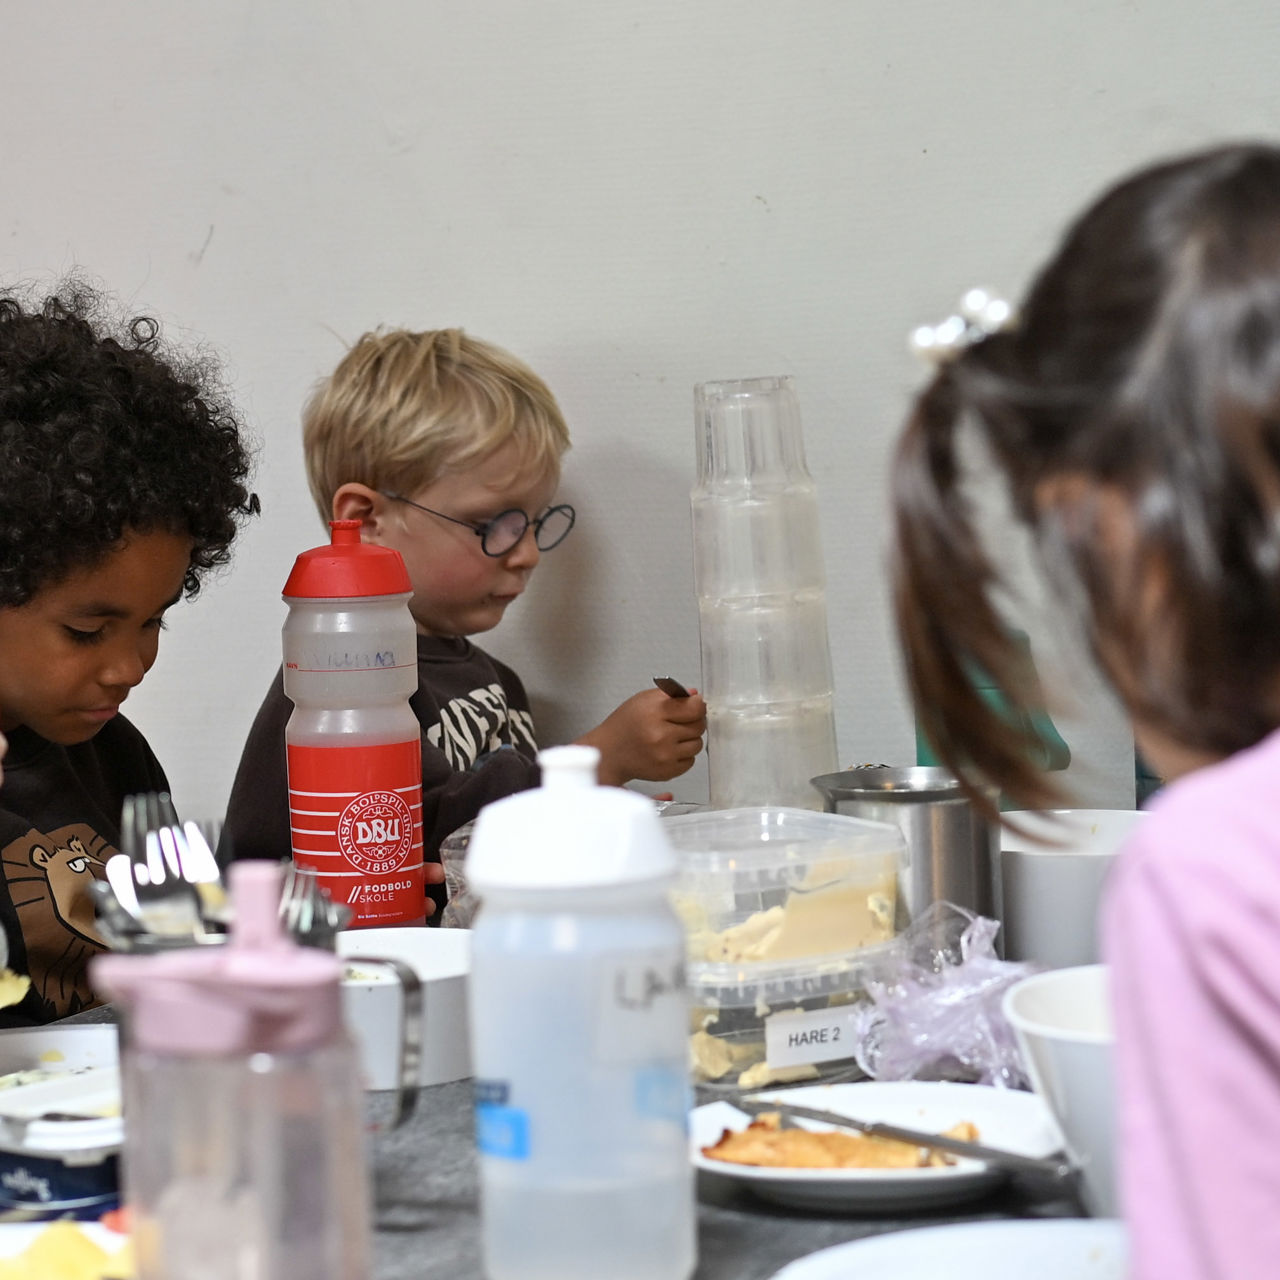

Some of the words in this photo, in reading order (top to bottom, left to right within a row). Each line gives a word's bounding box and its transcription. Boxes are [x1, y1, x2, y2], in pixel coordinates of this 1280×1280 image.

[341, 815, 362, 864] DANSK
[356, 818, 400, 844] DBU
[366, 858, 396, 872] 1889
[365, 880, 412, 893] FODBOLD
[360, 892, 394, 903] SKOLE
[789, 1028, 828, 1047] HARE
[833, 1027, 840, 1041] 2
